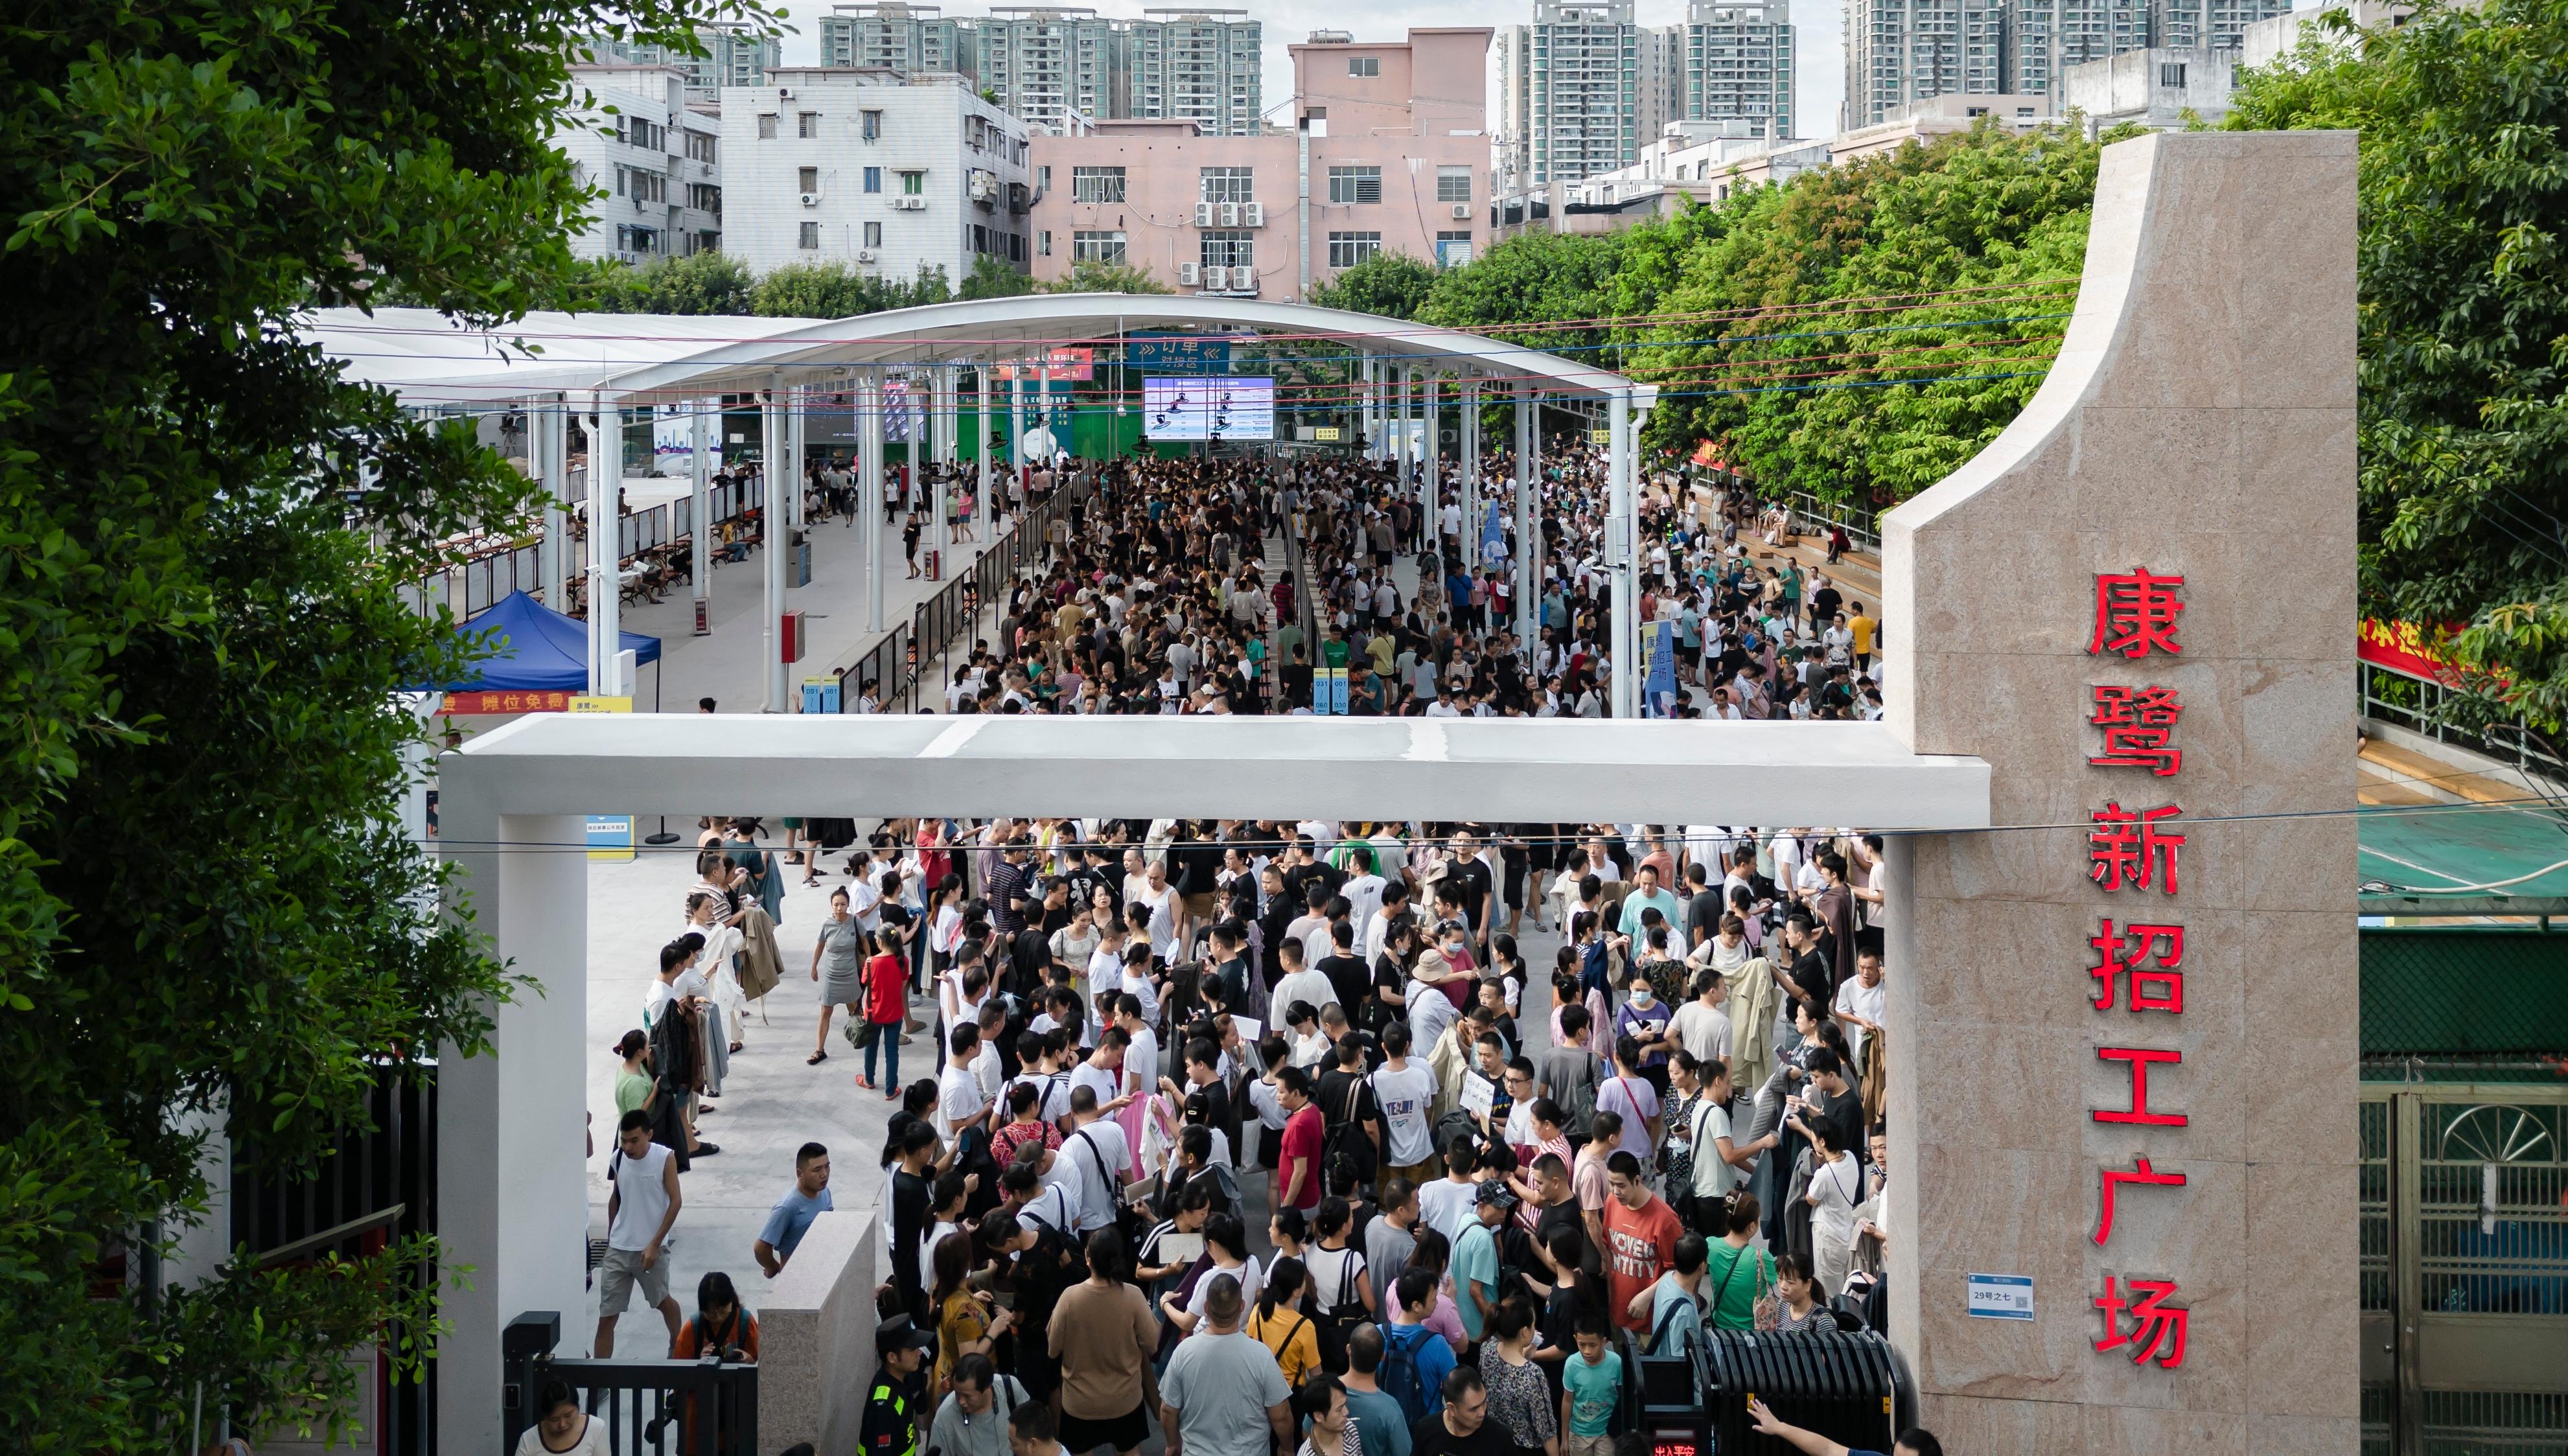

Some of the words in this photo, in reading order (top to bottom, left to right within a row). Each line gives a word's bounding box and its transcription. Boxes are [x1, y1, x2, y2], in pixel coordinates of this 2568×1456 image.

[1162, 336, 1198, 354] 订单
[1161, 356, 1197, 368] 对接区
[1647, 634, 1663, 649] 康鹭
[1648, 651, 1672, 665] 新招工
[1648, 668, 1667, 682] 广场
[481, 693, 564, 711] 摊位免费
[2085, 566, 2189, 1370] 康鹭新招工广场
[1974, 1291, 2011, 1301] 29号之七
